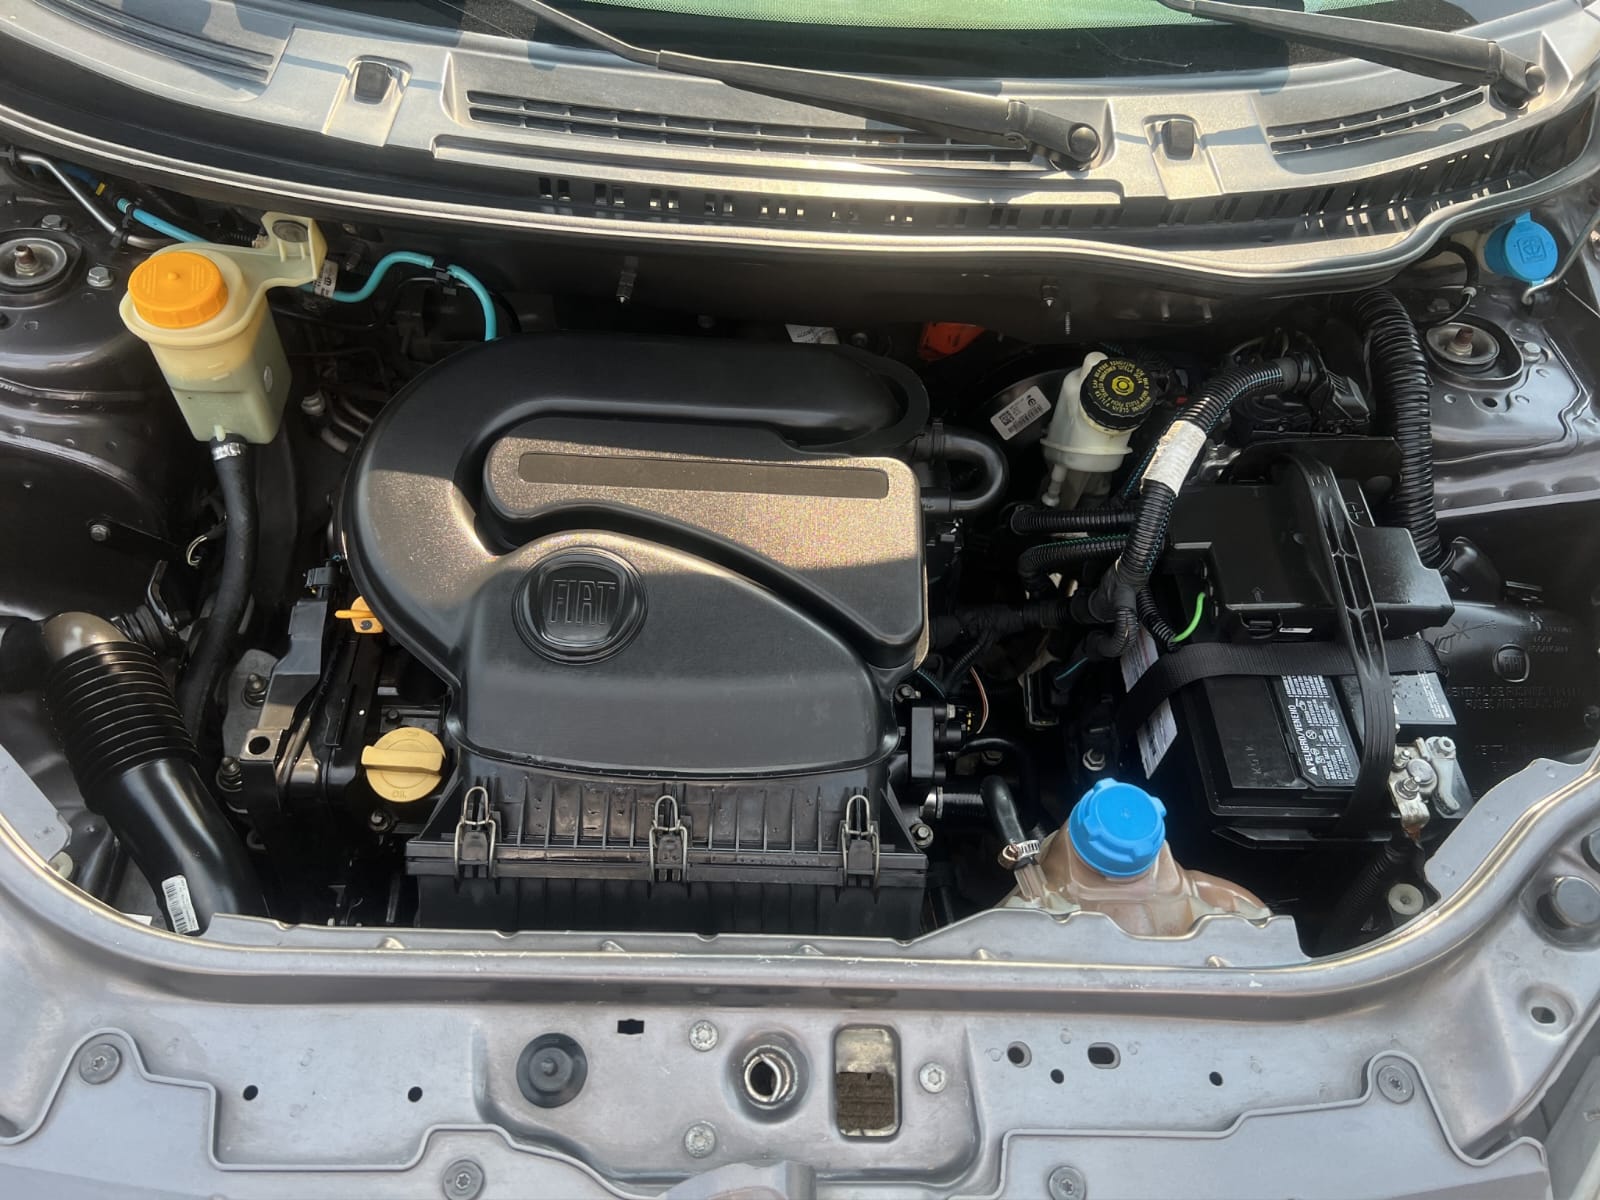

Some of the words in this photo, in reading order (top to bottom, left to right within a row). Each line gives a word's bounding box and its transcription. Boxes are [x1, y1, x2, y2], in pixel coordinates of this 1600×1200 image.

[549, 579, 617, 625] FIAT
[1502, 655, 1523, 672] FIAT
[1288, 704, 1313, 767] PELIGRO/VENENO
